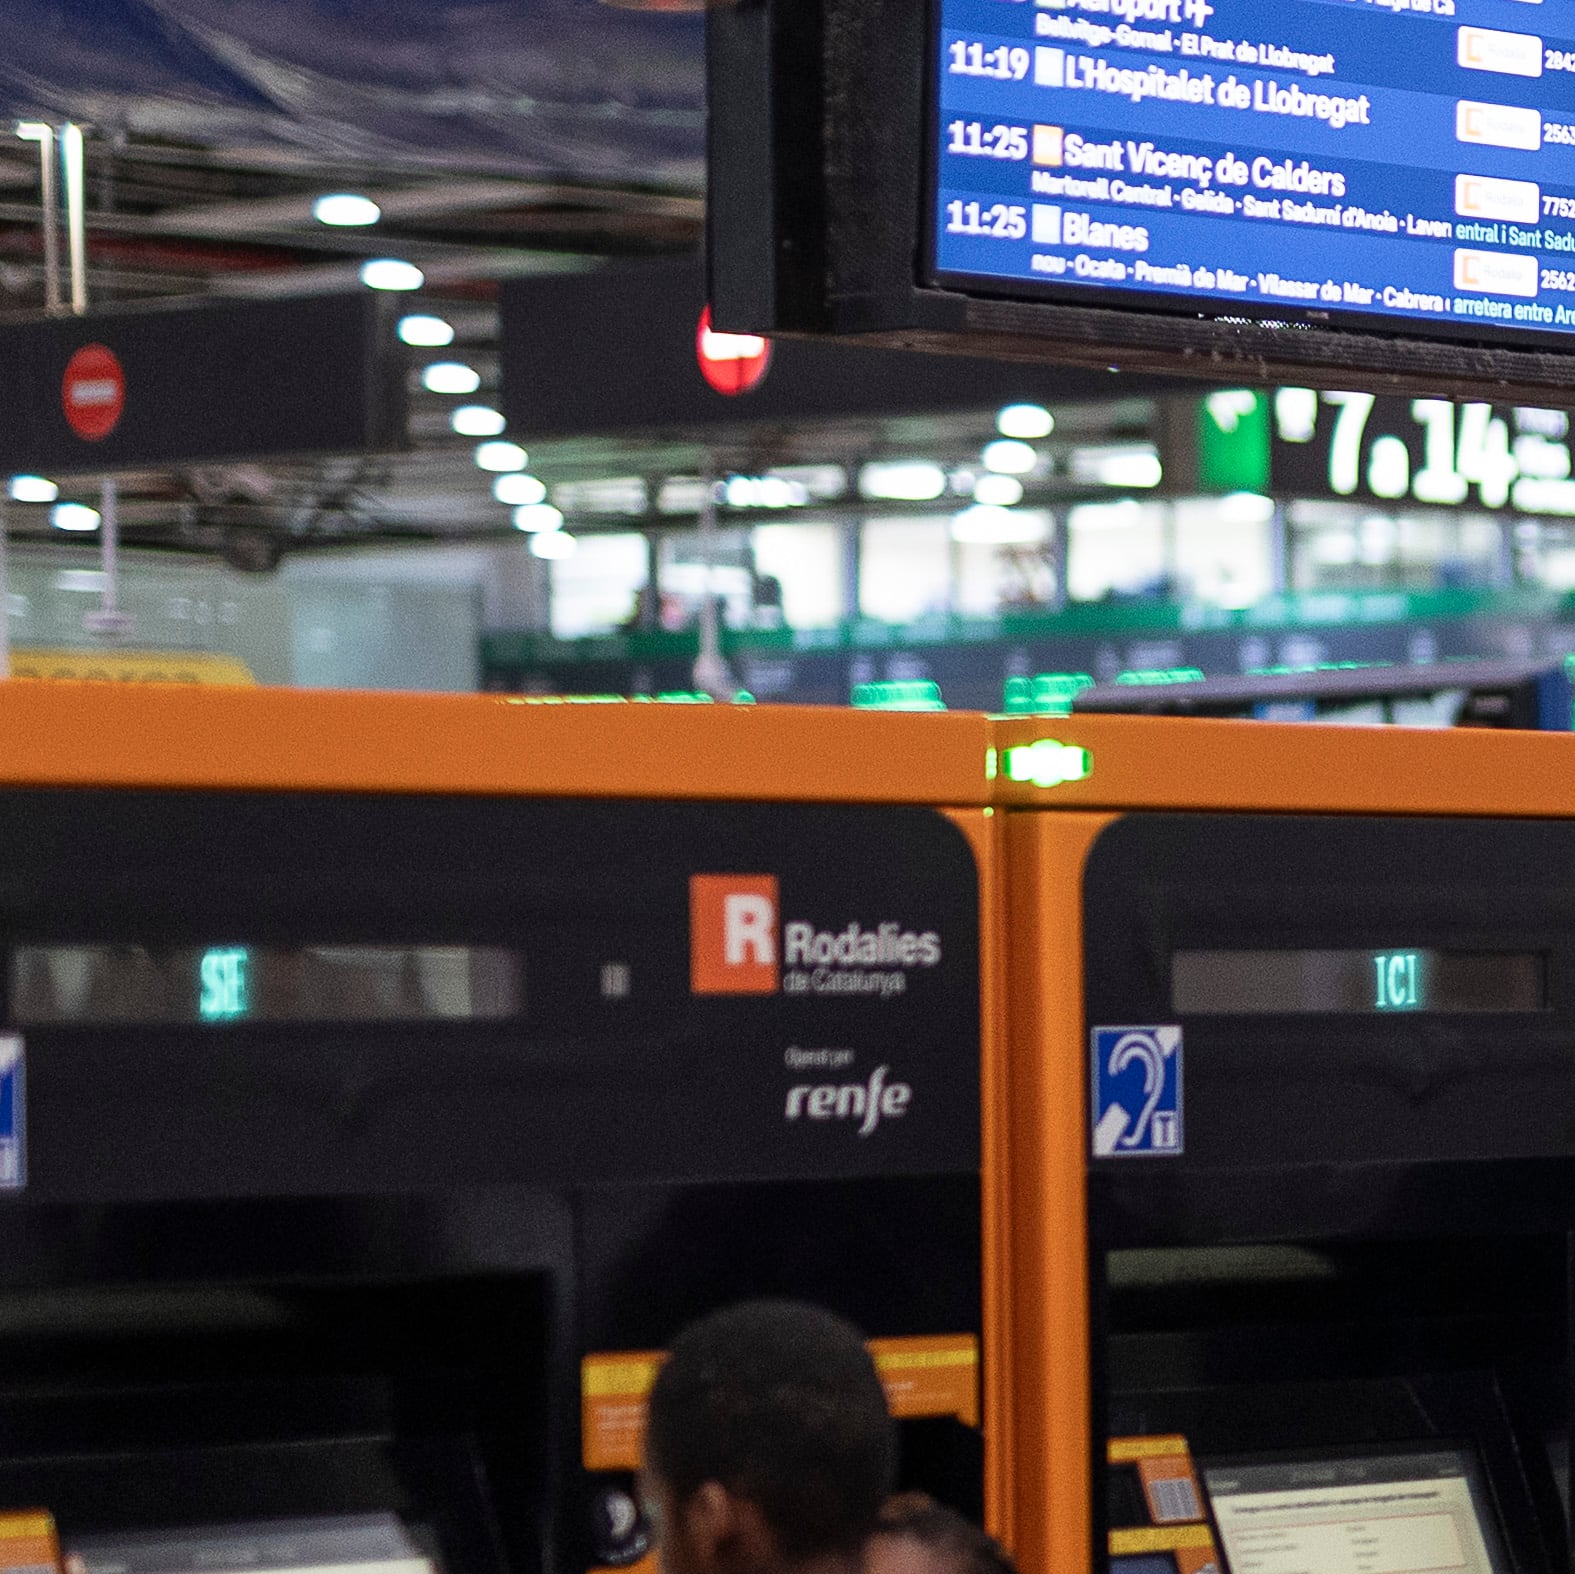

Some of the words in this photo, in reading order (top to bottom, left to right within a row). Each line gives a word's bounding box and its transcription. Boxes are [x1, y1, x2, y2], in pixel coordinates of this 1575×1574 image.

[950, 41, 1029, 80] 11:19
[1066, 55, 1215, 104] L'Hospitalet
[1217, 75, 1250, 109] de
[1254, 79, 1370, 129] Llobregat
[949, 120, 1028, 160] 11:25
[1064, 134, 1125, 172] Sant
[1127, 140, 1213, 188] Vicenç
[1215, 152, 1249, 185] de
[1252, 156, 1346, 197] Calders
[947, 200, 1026, 239] 11:25
[1063, 212, 1149, 251] Blanes
[1456, 221, 1498, 244] entral
[1501, 224, 1507, 244] i
[1509, 226, 1541, 248] Sant
[1454, 297, 1512, 319] arretera
[1514, 302, 1553, 322] entre
[724, 894, 776, 965] R
[784, 921, 941, 966] Rodalies
[783, 970, 810, 994] de
[811, 968, 906, 999] Catalunya
[785, 1064, 912, 1137] renfe
